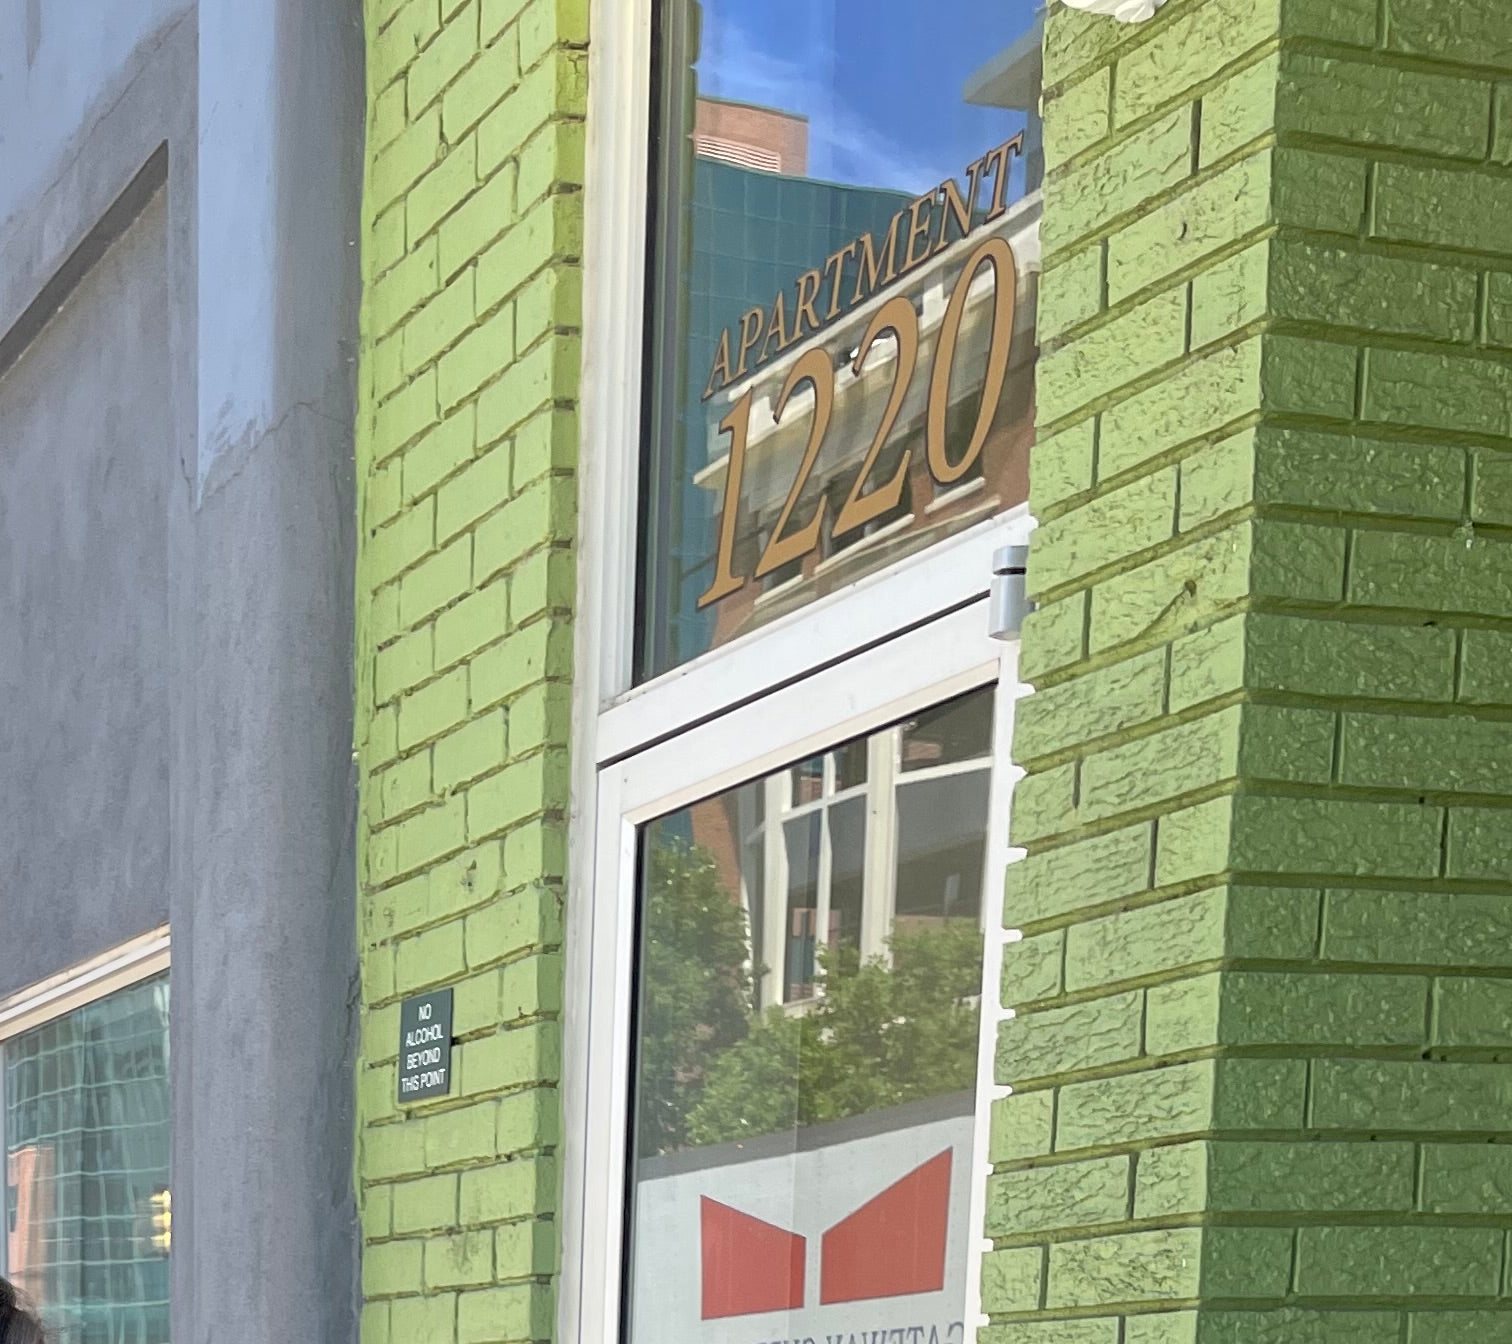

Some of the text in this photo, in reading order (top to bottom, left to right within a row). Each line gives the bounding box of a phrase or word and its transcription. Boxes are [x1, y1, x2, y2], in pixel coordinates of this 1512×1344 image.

[701, 131, 1024, 403] APARTMENT
[697, 236, 1017, 609] 1220
[419, 1003, 432, 1021] NO
[405, 1024, 444, 1047] ALCOHOL
[406, 1047, 441, 1070] BEYOND
[401, 1069, 446, 1093] THIS POINT
